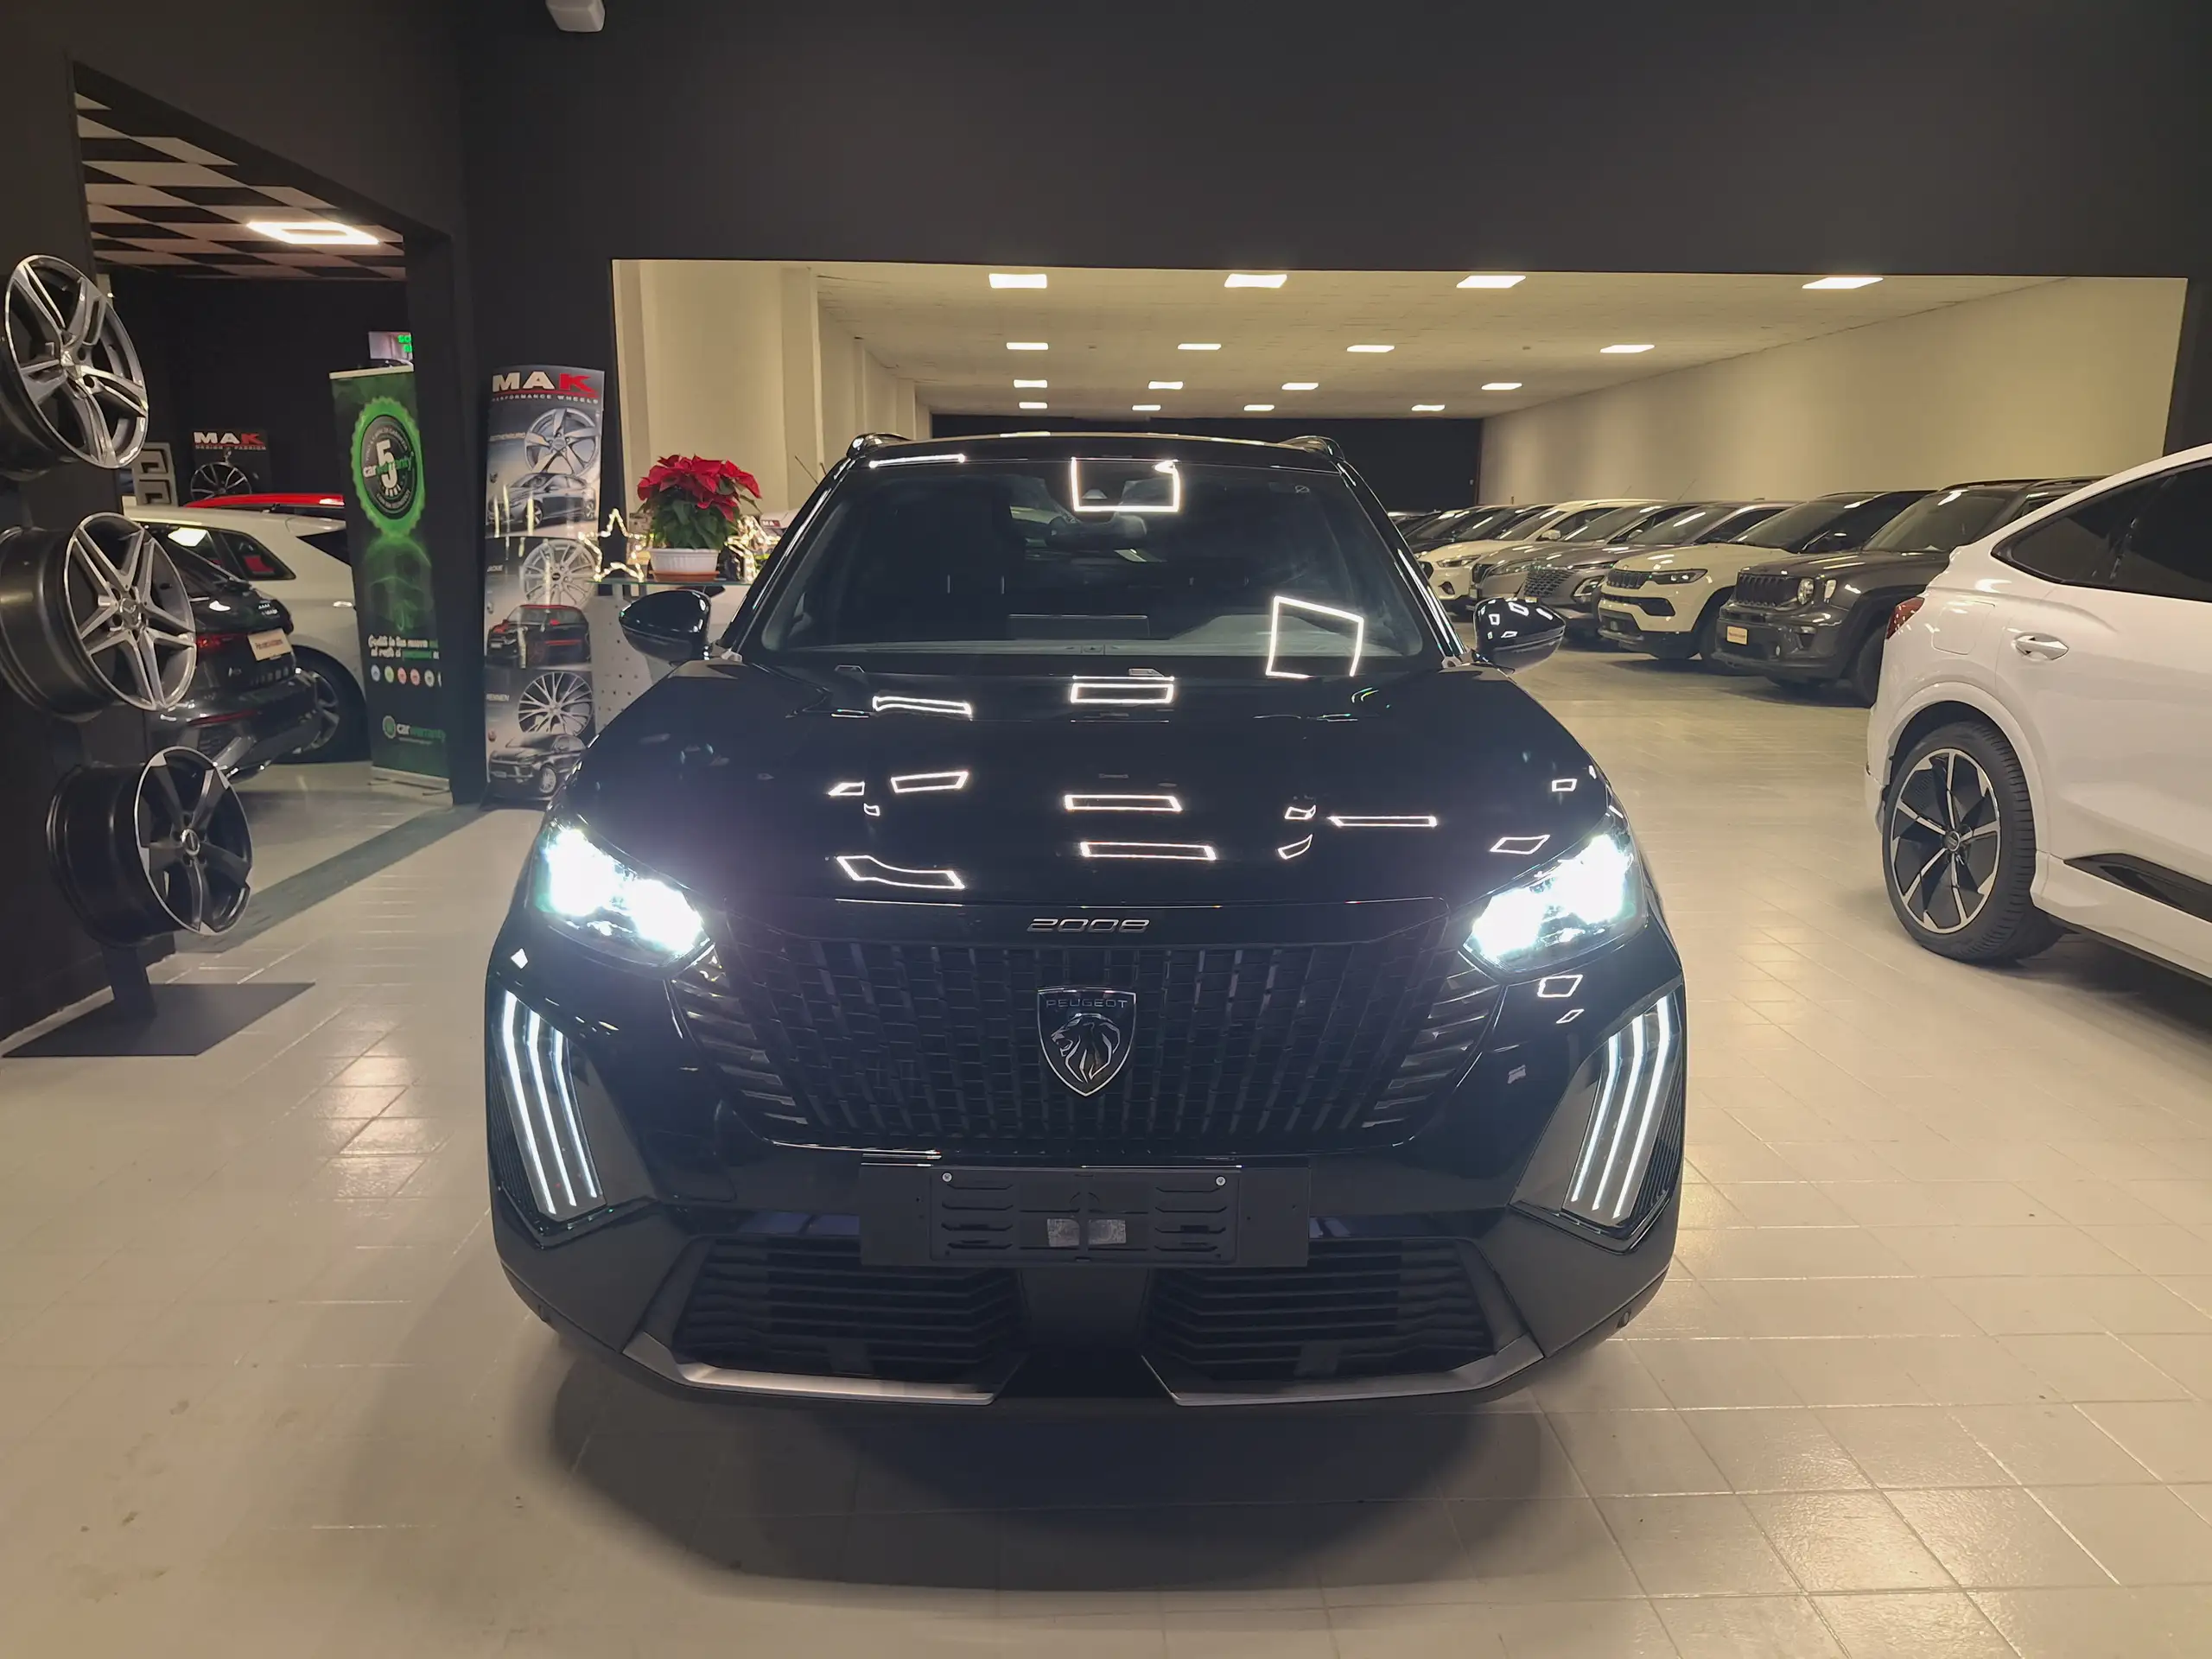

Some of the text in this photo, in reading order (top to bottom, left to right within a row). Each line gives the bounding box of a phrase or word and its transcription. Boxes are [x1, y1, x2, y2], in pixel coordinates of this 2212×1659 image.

[492, 371, 598, 393] MAK
[557, 395, 599, 404] WHEELS
[194, 432, 264, 446] MAK
[376, 439, 397, 489] 5
[1027, 918, 1150, 933] 2008
[1046, 999, 1128, 1008] PEUGEOT
